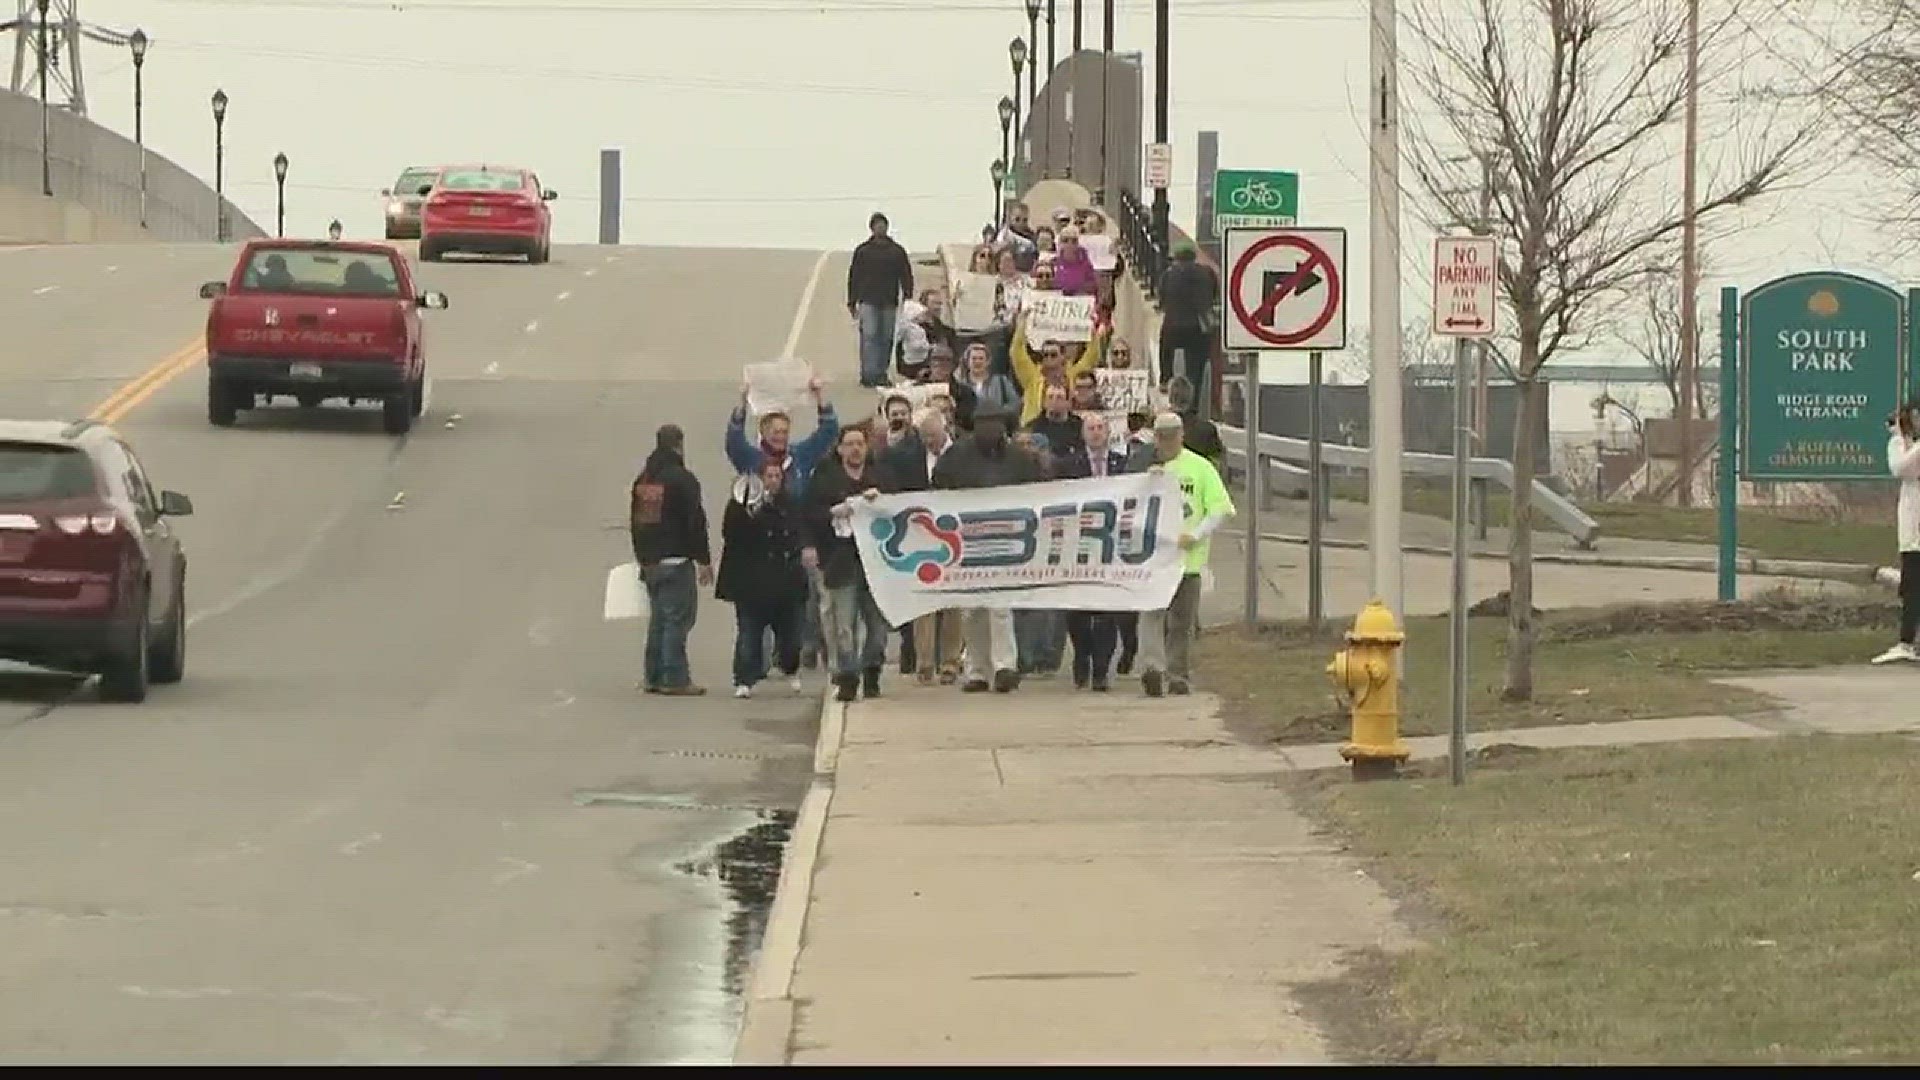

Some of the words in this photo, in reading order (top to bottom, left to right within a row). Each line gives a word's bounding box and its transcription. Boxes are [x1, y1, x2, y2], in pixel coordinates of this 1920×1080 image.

[1453, 247, 1477, 263] NO
[1439, 266, 1490, 284] PARKING
[1452, 286, 1475, 298] ANY
[1451, 301, 1477, 314] TIME
[1777, 329, 1867, 350] SOUTH
[1791, 352, 1854, 371] PARK
[1777, 394, 1820, 406] RIDGE
[1826, 394, 1868, 406] ROAD
[1785, 407, 1859, 418] ENTRANCE
[960, 495, 1160, 566] BTRU
